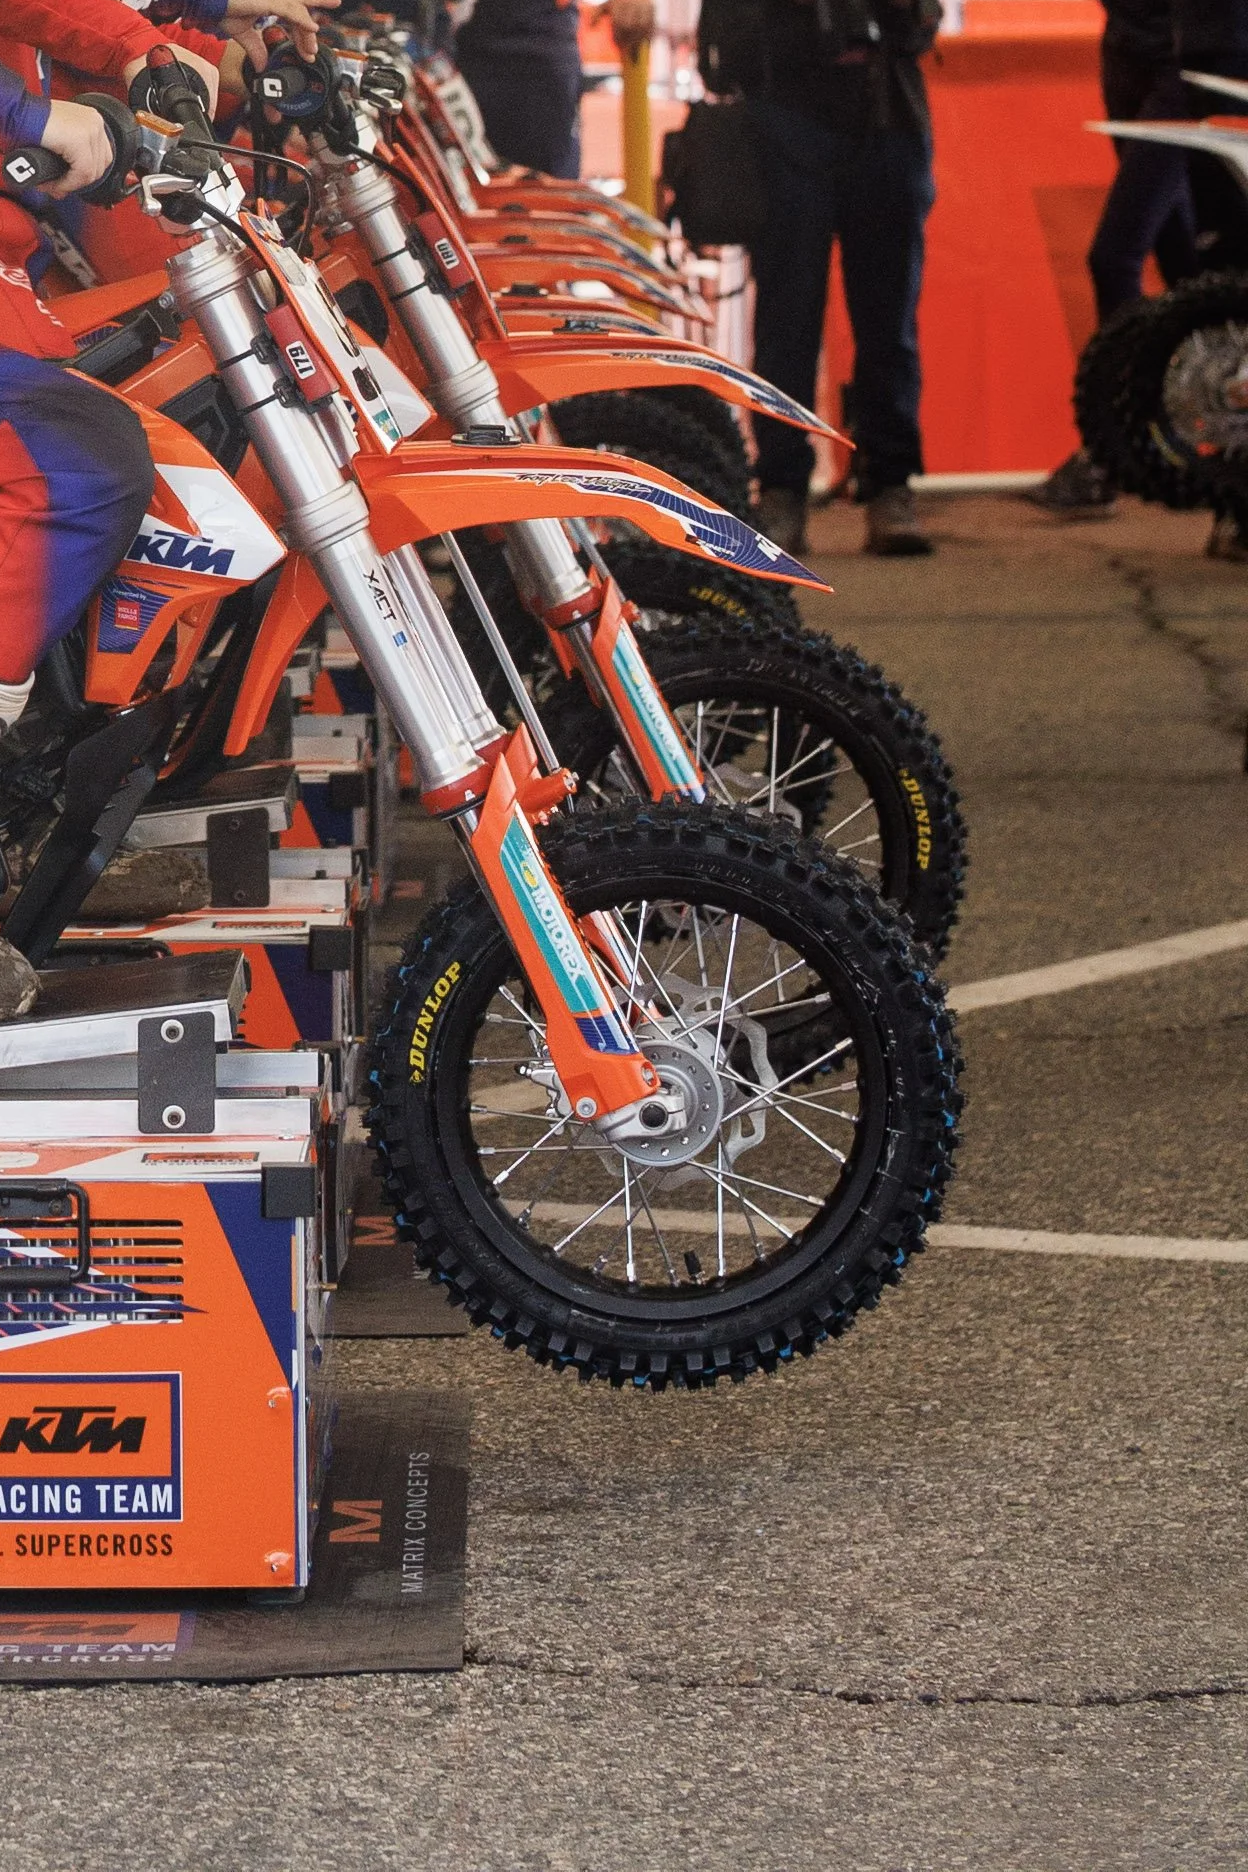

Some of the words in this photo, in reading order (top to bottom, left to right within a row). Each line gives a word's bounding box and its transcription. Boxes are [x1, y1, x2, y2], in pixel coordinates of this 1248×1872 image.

[288, 344, 314, 375] 179
[126, 530, 235, 575] KTM
[118, 606, 138, 615] WELLS
[363, 569, 397, 620] XACT
[901, 777, 932, 871] DUNLOP
[531, 888, 586, 985] MOTOREX
[409, 961, 461, 1071] DUNLOP
[97, 1485, 174, 1513] TEAM
[404, 1450, 431, 1529] CONCEPTS
[328, 1499, 384, 1543] M
[16, 1534, 174, 1557] SUPERCROSS
[400, 1537, 426, 1594] MATRIX
[46, 1643, 177, 1654] TEAM
